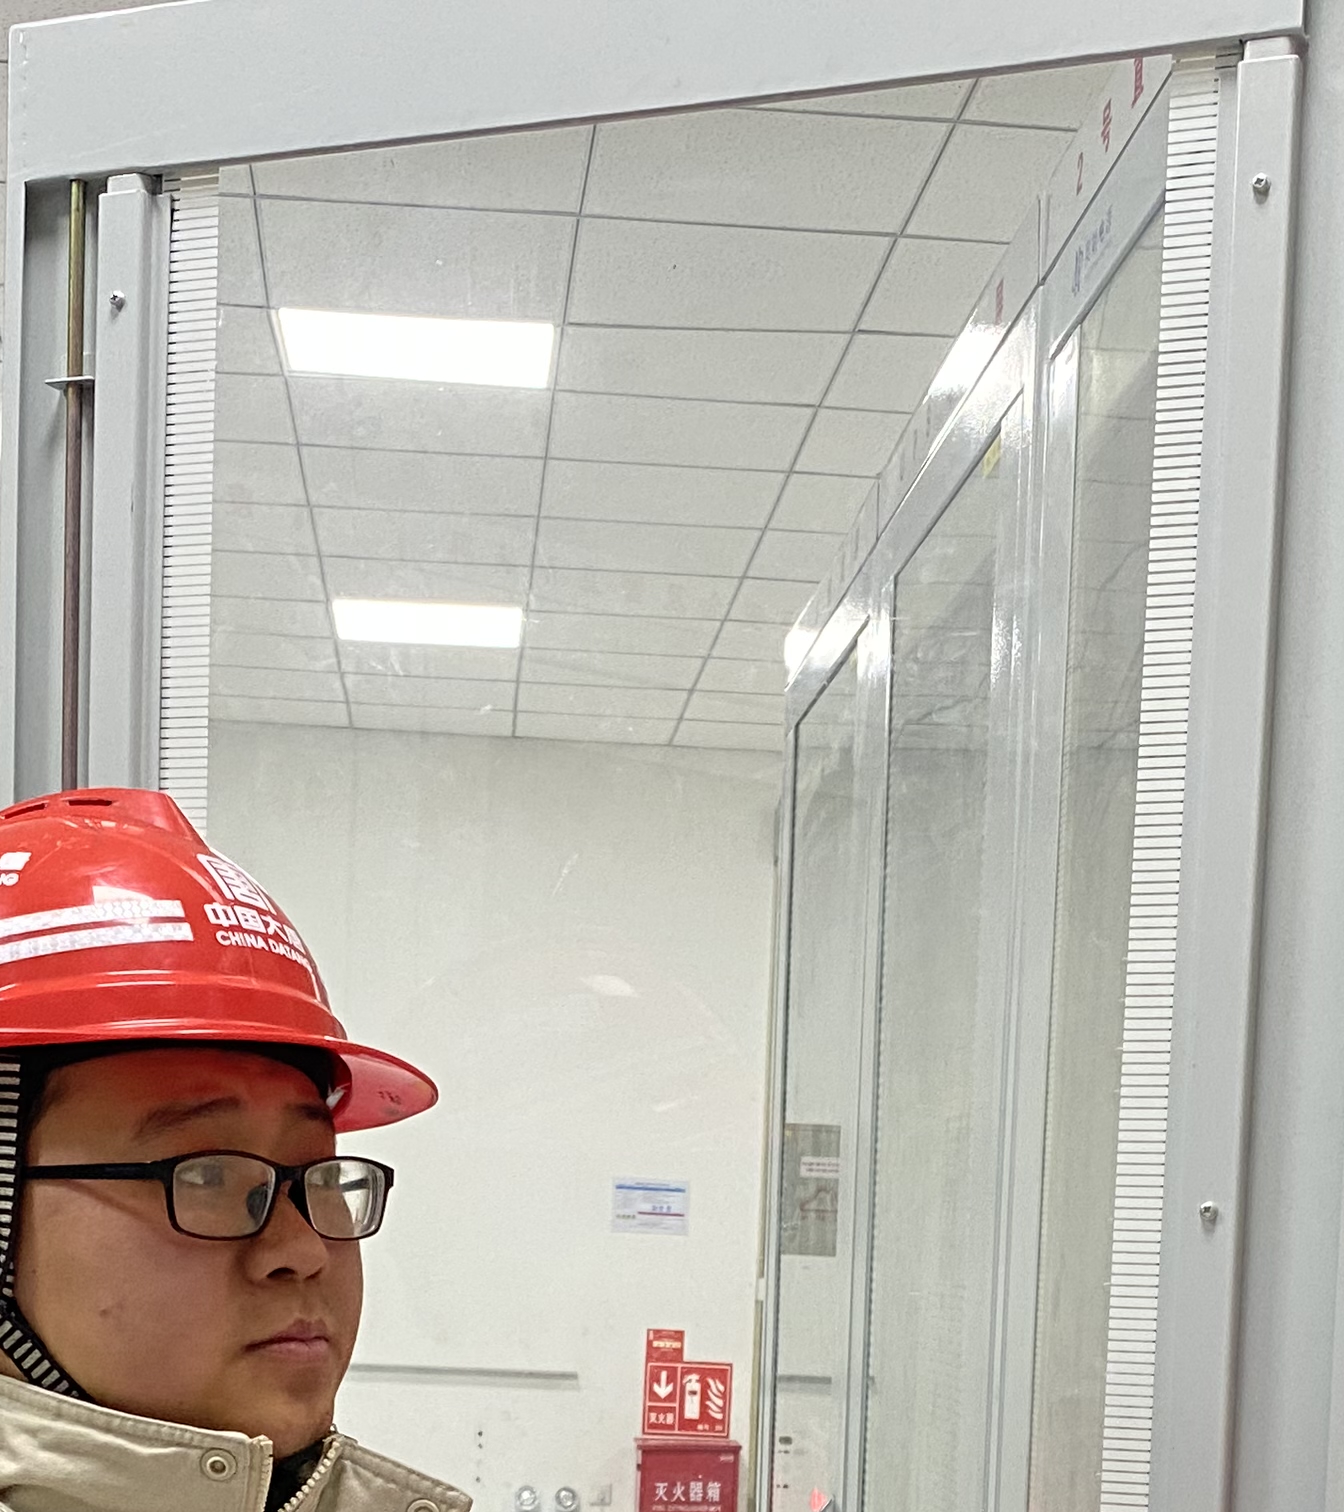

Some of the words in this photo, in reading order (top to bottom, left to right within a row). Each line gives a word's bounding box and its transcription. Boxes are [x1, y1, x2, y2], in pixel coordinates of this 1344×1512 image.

[216, 930, 269, 952] CHINA
[654, 1481, 722, 1503] 灭火器箱
